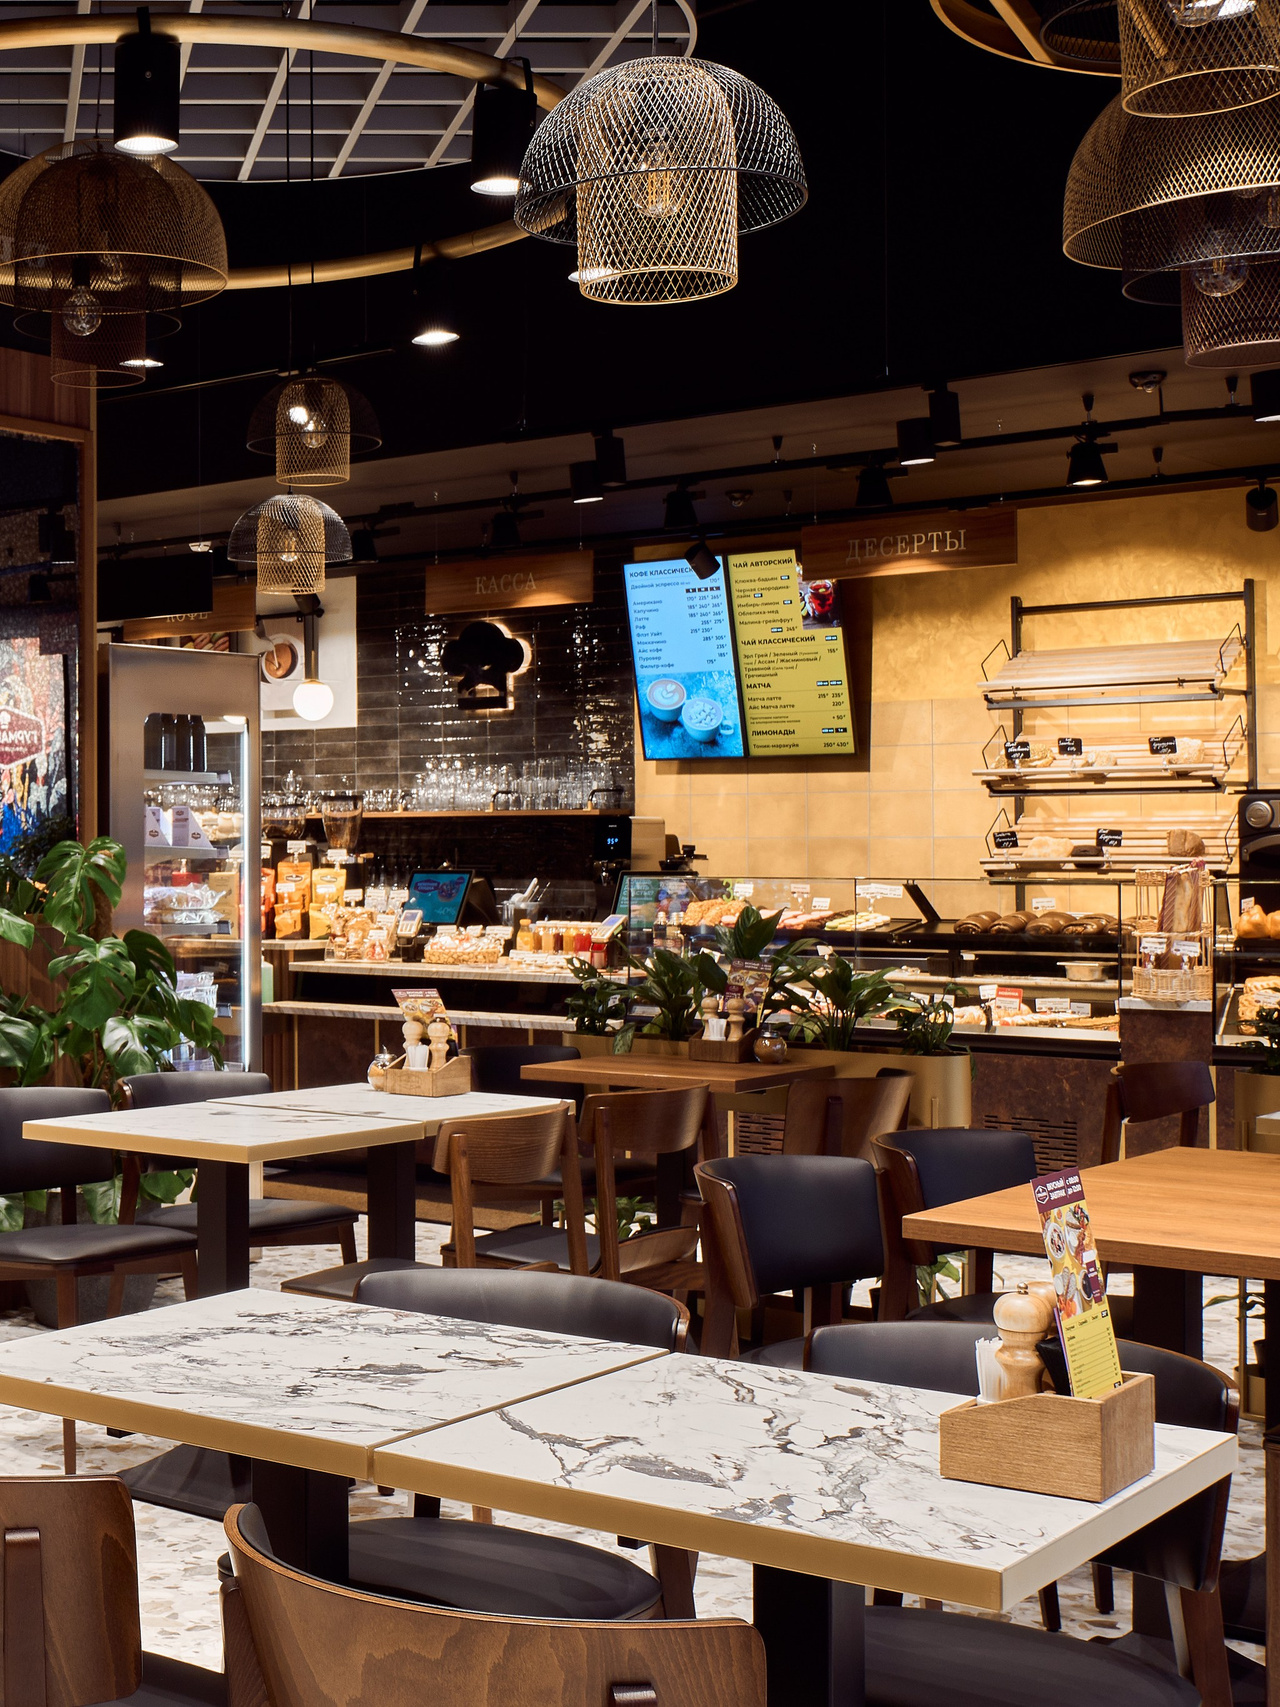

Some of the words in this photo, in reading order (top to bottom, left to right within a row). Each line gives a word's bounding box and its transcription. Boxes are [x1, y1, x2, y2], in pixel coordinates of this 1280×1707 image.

[846, 529, 967, 565] ДЕСЕРТЫ
[750, 557, 793, 567] АВТОРСКИЙ
[629, 570, 648, 578] КОФЕ
[475, 572, 537, 595] КАССА
[758, 635, 815, 645] КЛАССИЧЕСКИЙ
[752, 729, 795, 737] ЛИМОНАДЫ
